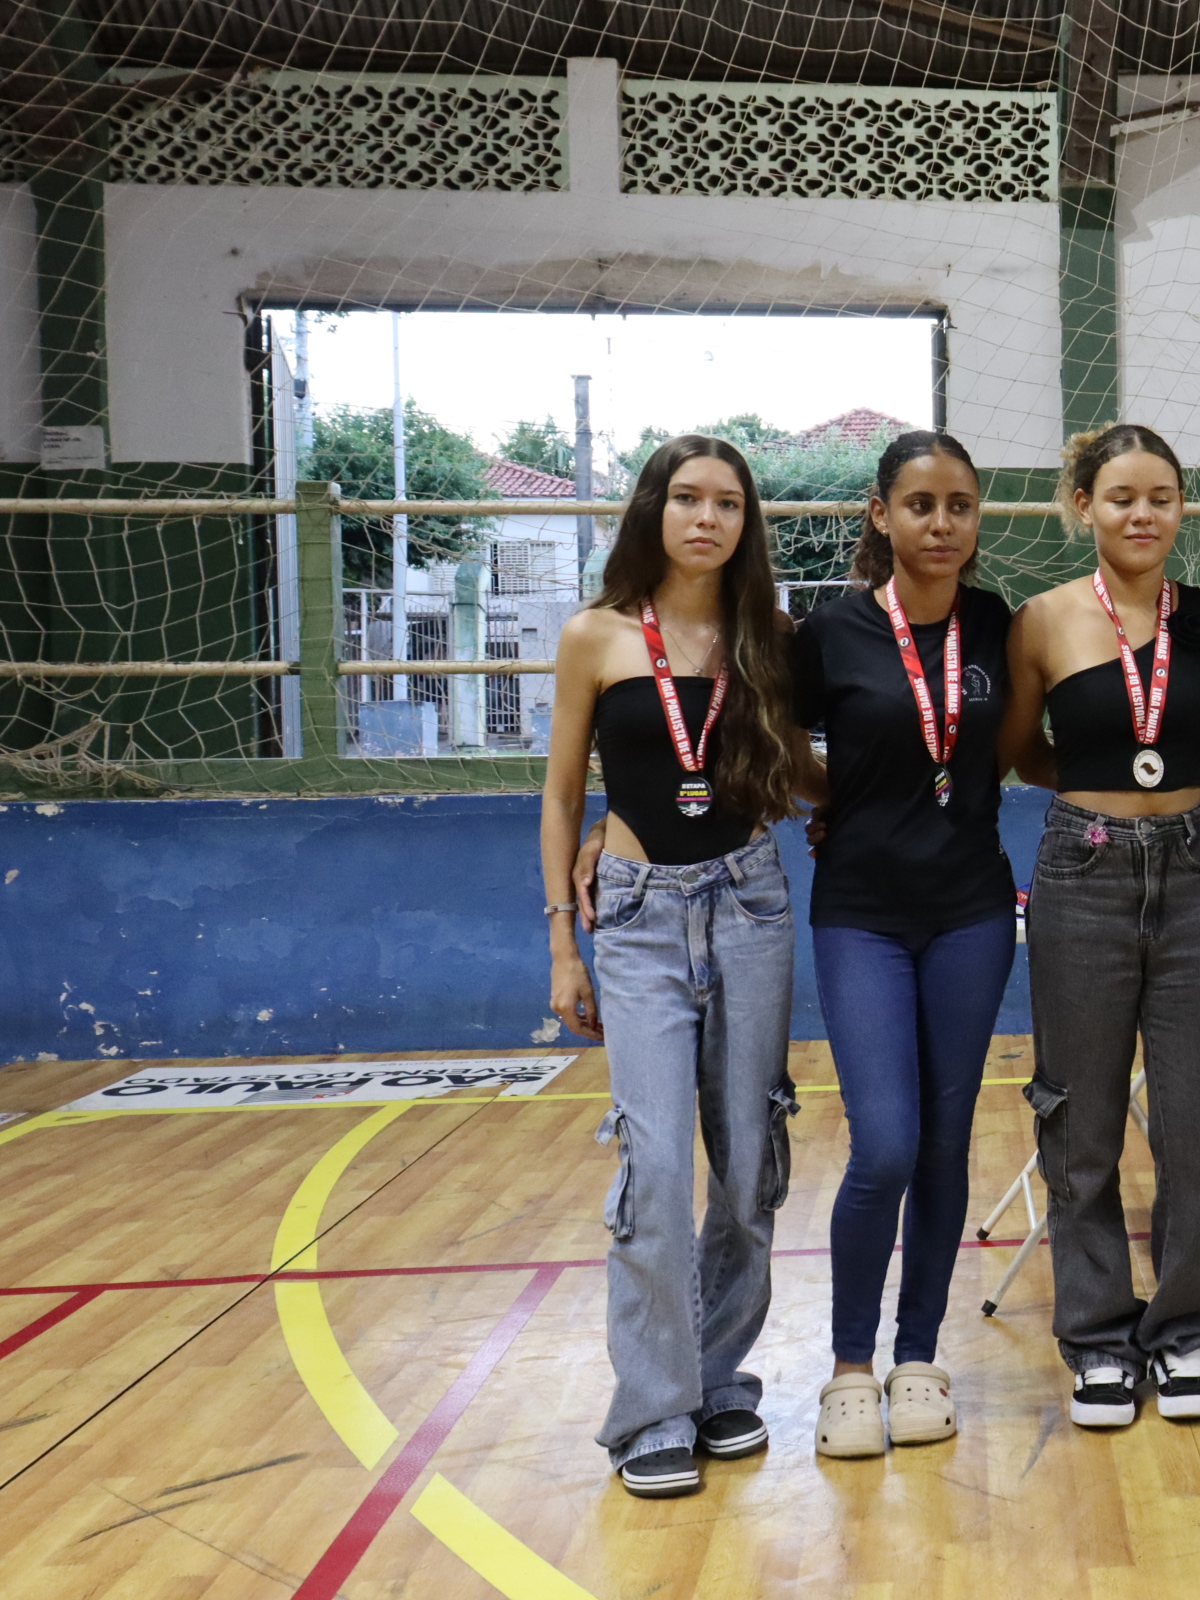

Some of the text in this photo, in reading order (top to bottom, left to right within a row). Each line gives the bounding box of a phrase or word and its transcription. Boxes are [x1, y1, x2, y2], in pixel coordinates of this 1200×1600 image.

[891, 609, 905, 630] LIGA
[947, 630, 958, 670] PAULISTA
[1157, 630, 1169, 660] DAMAS
[1121, 644, 1137, 674] DAMAS
[660, 677, 675, 698] LIGA
[947, 670, 958, 682] DE
[1128, 674, 1140, 686] DE
[914, 677, 931, 709] DAMAS
[947, 683, 958, 714] DAMAS
[1150, 687, 1163, 707] LIGA
[922, 709, 934, 722] DE
[1131, 685, 1146, 728] PAULISTA
[665, 698, 687, 742] PAULISTA
[677, 740, 691, 755] DE
[100, 1072, 549, 1097] SÃO PAULO
[123, 1065, 558, 1085] GOVERNO DO ESTADO
